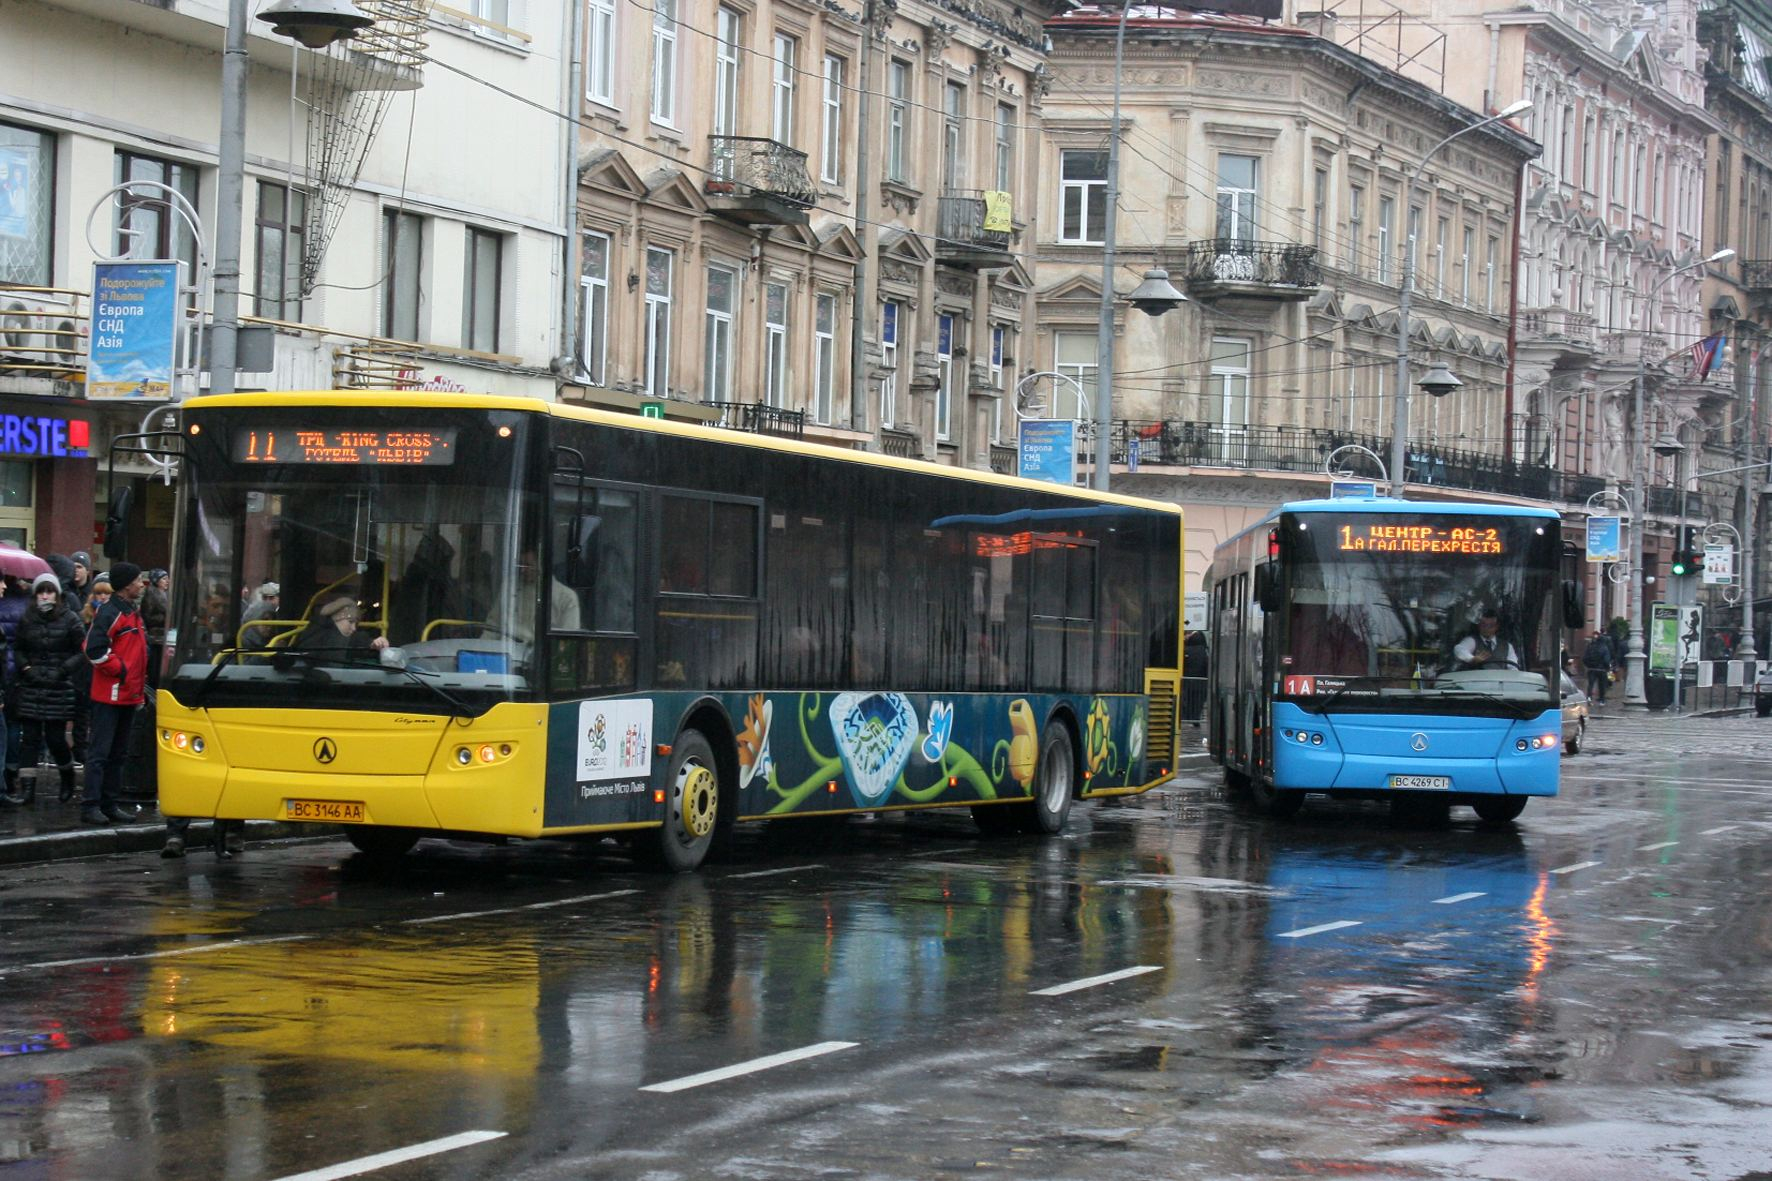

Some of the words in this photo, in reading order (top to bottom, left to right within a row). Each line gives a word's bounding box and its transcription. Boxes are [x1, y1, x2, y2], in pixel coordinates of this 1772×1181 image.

[99, 303, 144, 317] Європа
[98, 319, 125, 334] СНД
[97, 335, 123, 348] Азія
[0, 414, 67, 457] RSTE
[246, 432, 277, 461] 11
[1370, 526, 1433, 539] ЦЕНТР
[1451, 528, 1498, 541] АС-2
[1368, 538, 1502, 553] ГАЛ.ПЕРЕХРЕСТЯ
[1395, 777, 1409, 787] BC
[1410, 777, 1432, 788] 4269
[294, 802, 312, 816] BC
[314, 803, 341, 817] 3146
[343, 805, 361, 819] AA
